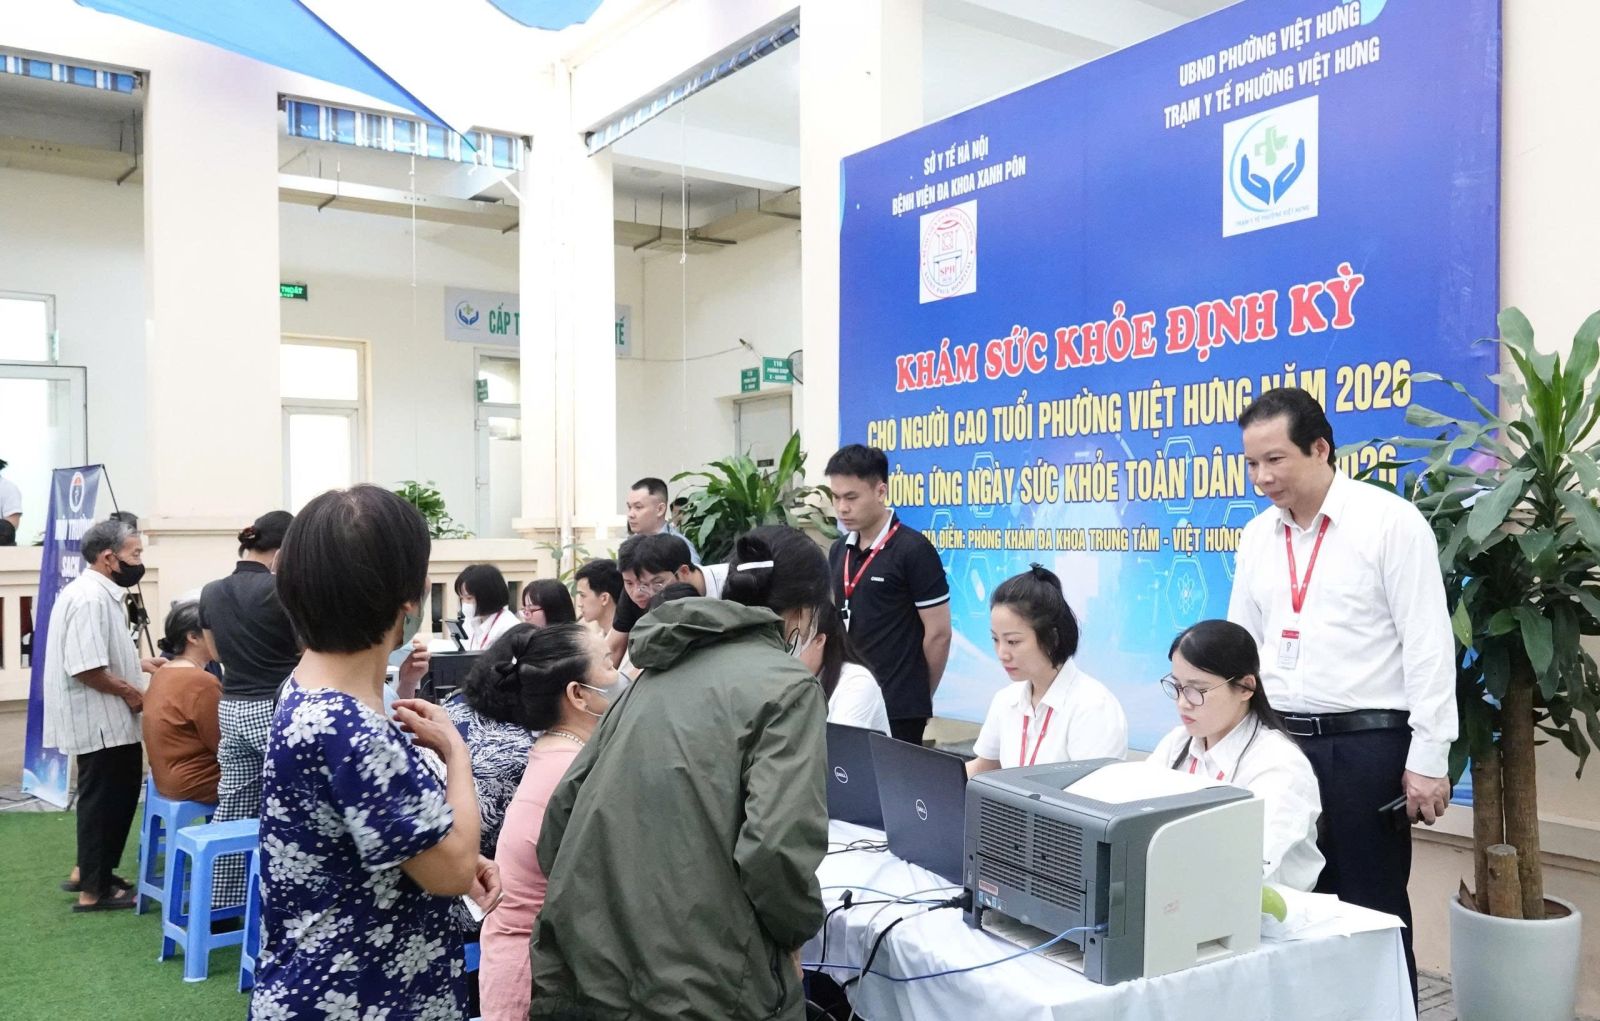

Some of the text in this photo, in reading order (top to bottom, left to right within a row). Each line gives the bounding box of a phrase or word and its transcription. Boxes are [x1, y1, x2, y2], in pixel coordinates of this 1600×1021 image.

[1179, 1, 1360, 87] UBND PHƯỜNG VIỆT HƯNG
[1164, 36, 1380, 129] TRẠM Y TẾ PHƯỜNG VIỆT HƯNG
[892, 155, 1027, 217] BỆNH VIỆN ĐA KHOA XANH PÔN
[923, 134, 989, 176] SỞ Y TẾ HÀ NỘI
[488, 302, 511, 335] CẤP
[896, 262, 1365, 393] KHÁM SỨC KHỎE ĐỊNH KỲ
[867, 419, 897, 451] CHO
[901, 405, 949, 450] NGƯỜI
[954, 408, 988, 446] CAO
[992, 389, 1034, 442] TUỔI
[1039, 387, 1122, 439] PHƯỜNG
[1128, 379, 1177, 438] VIỆT
[1183, 376, 1252, 427] HƯNG
[1335, 359, 1411, 412] 2026
[929, 464, 964, 506] ỨNG
[968, 461, 1015, 506] NGÀY
[1020, 458, 1059, 504] SỨC
[1064, 448, 1120, 503] KHỎE
[1125, 449, 1187, 501] TOÀN
[1193, 446, 1246, 499] DÂN
[968, 525, 1002, 549] PHÒNG
[1004, 525, 1036, 550] KHÁM
[1037, 529, 1053, 550] ĐA
[1055, 528, 1087, 551] KHOA
[1088, 528, 1127, 551] TRUNG
[1132, 523, 1160, 551] TÂM
[1172, 522, 1202, 556] VIỆT
